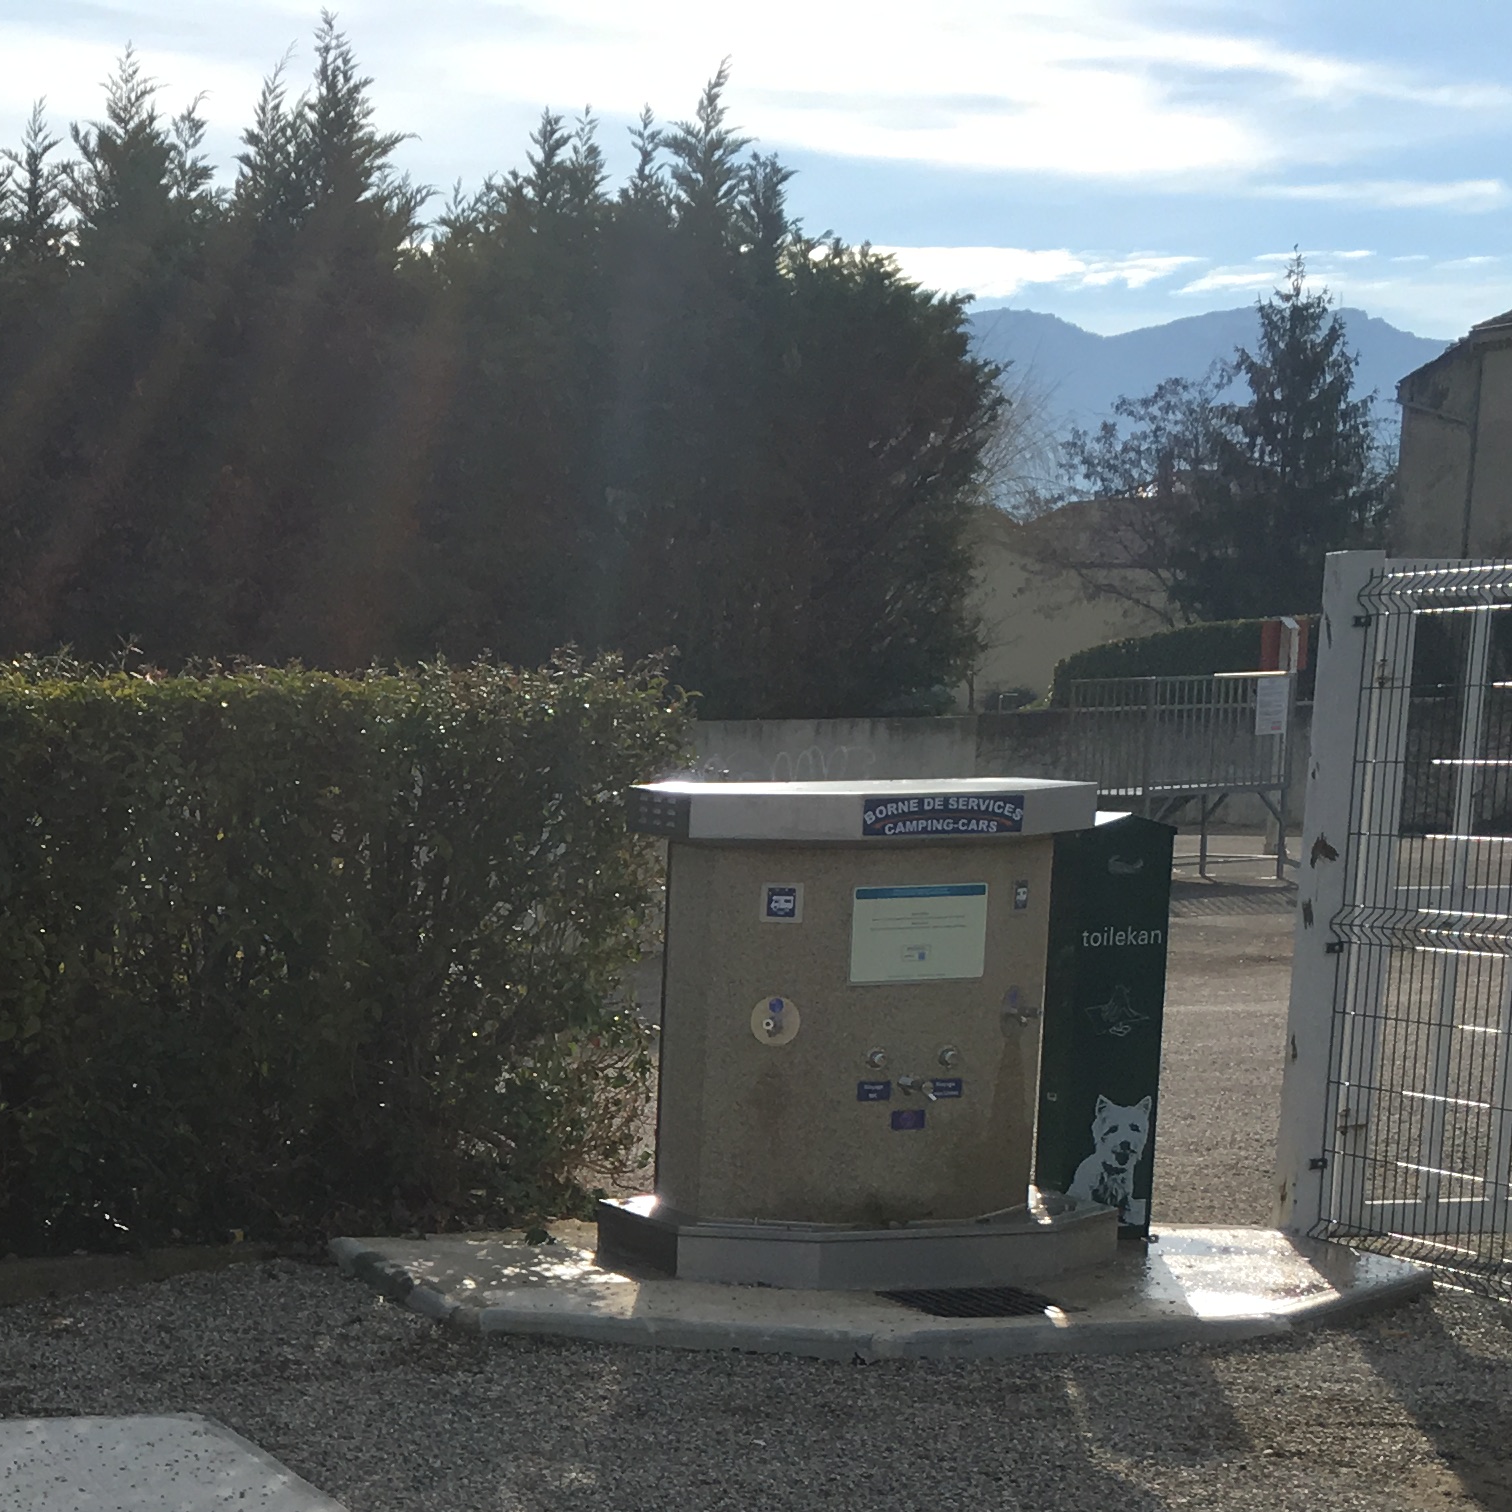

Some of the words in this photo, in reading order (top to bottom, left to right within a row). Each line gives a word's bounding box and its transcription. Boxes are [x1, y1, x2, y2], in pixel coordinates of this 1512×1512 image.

[863, 799, 919, 825] BORNE
[923, 797, 944, 810] DE
[948, 797, 1024, 821] SERVICES
[884, 818, 998, 835] CAMPING-CARS
[1082, 926, 1162, 947] toilekan
